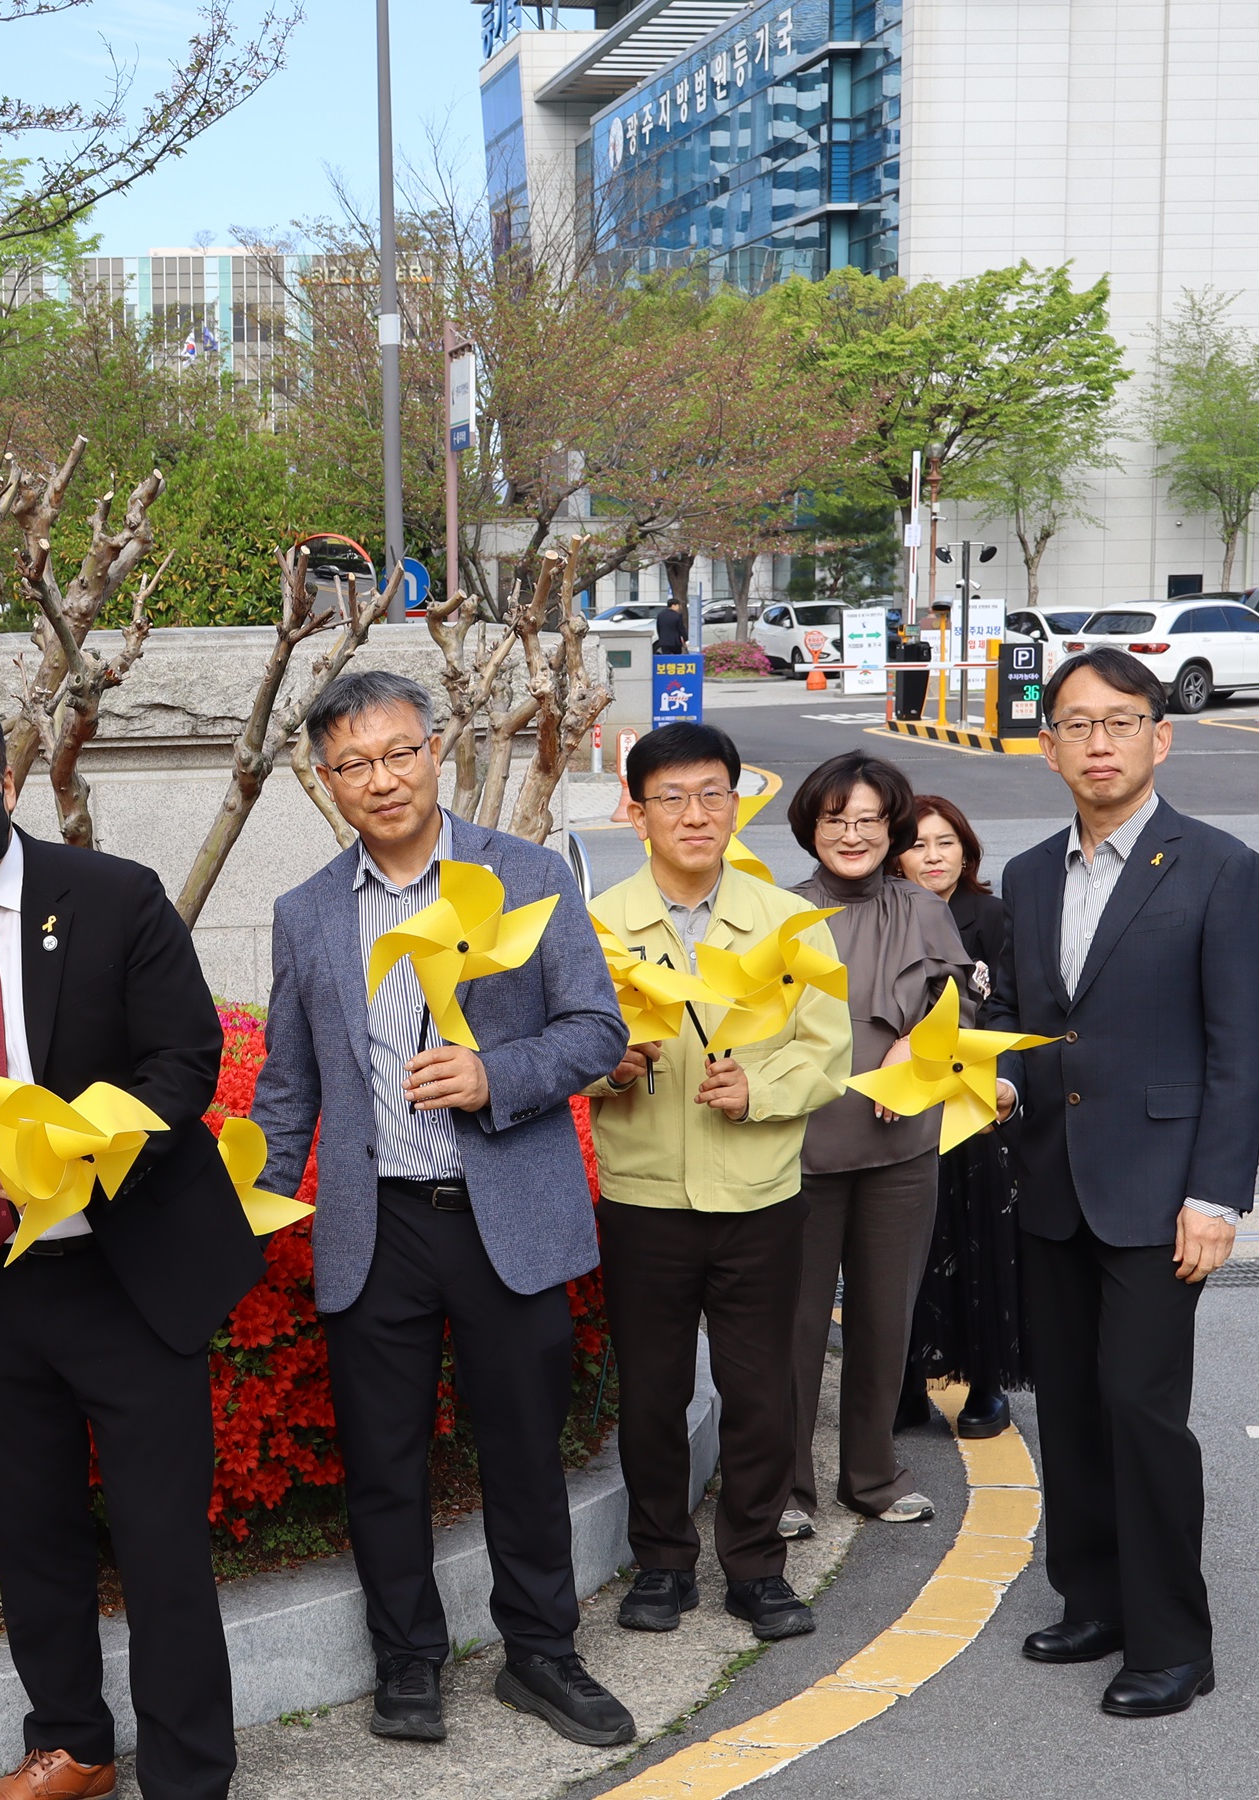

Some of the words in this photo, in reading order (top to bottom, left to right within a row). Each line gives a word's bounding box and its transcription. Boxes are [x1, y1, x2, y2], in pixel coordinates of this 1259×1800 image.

[625, 8, 793, 155] 광주지방법원등기국
[656, 663, 696, 675] 보행금지
[1023, 685, 1040, 701] 36
